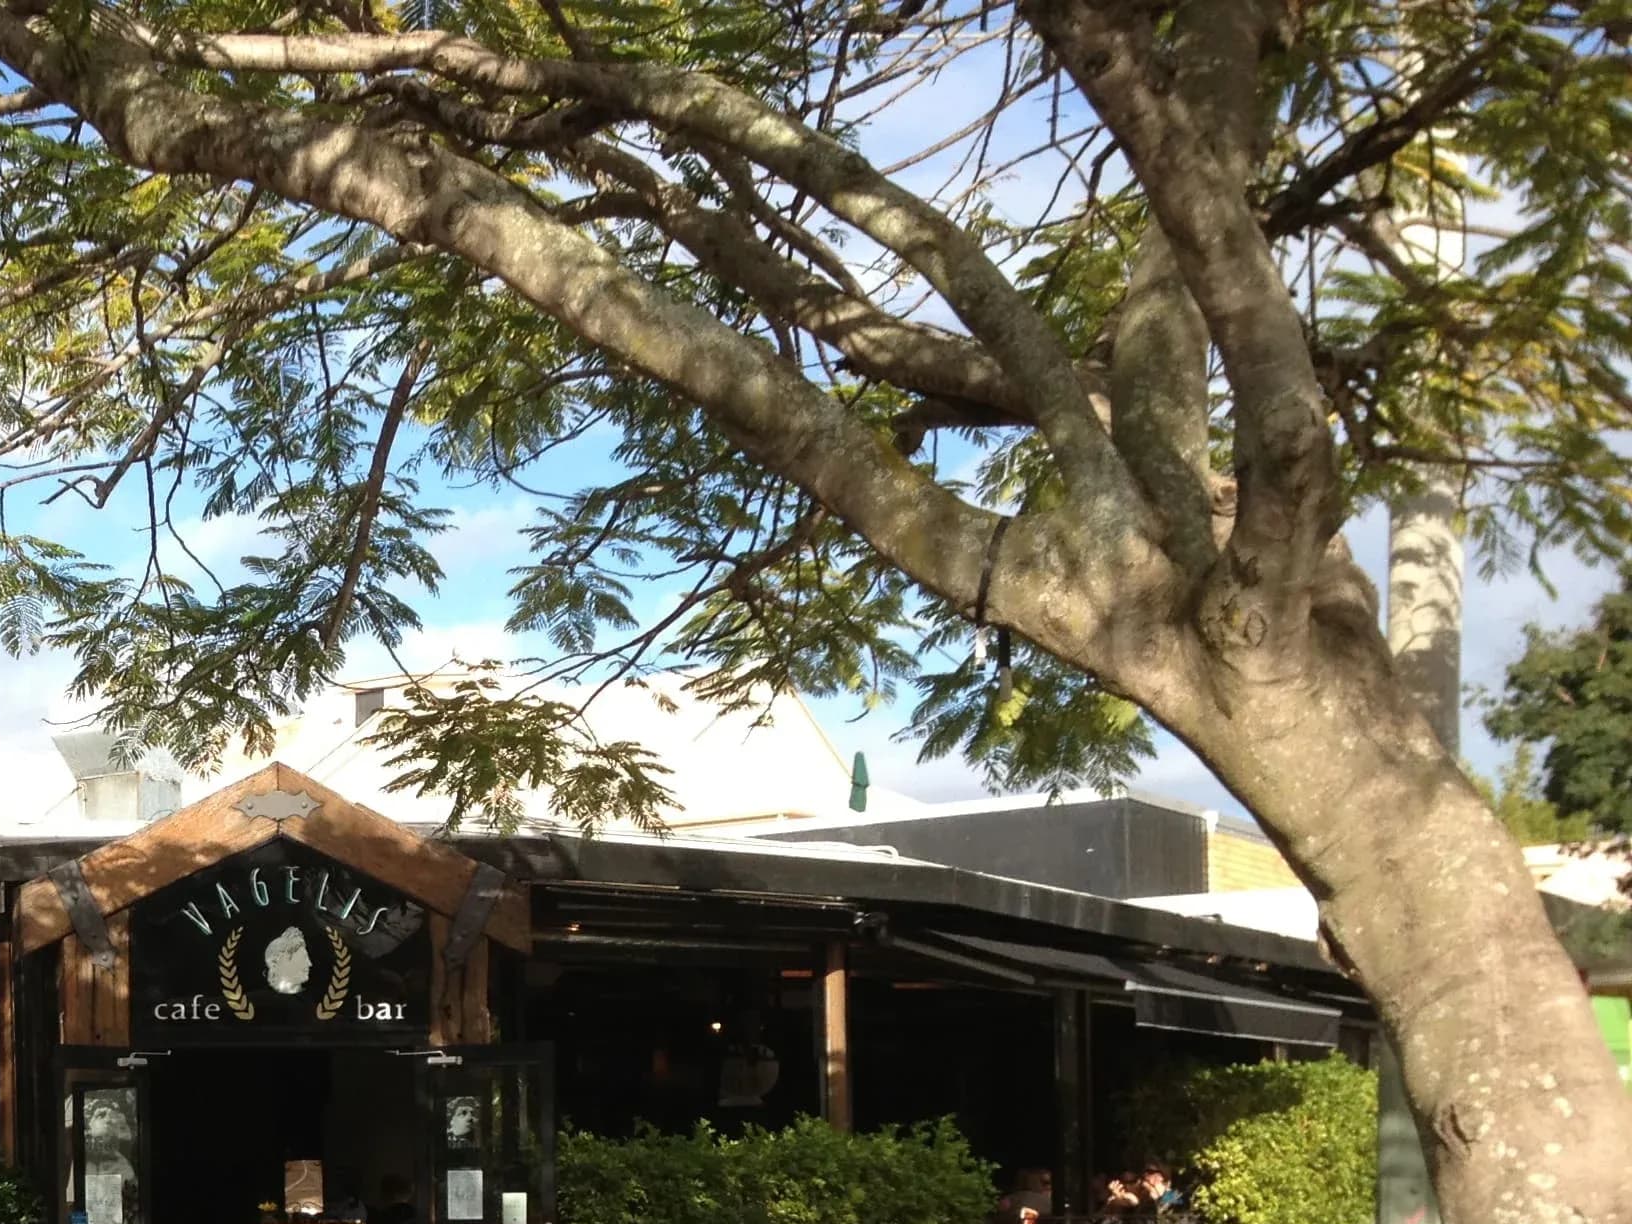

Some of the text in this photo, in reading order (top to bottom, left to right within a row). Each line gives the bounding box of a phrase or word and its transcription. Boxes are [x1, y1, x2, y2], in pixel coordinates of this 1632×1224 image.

[181, 866, 389, 935] VAGELIS
[153, 994, 408, 1021] cafe bar
